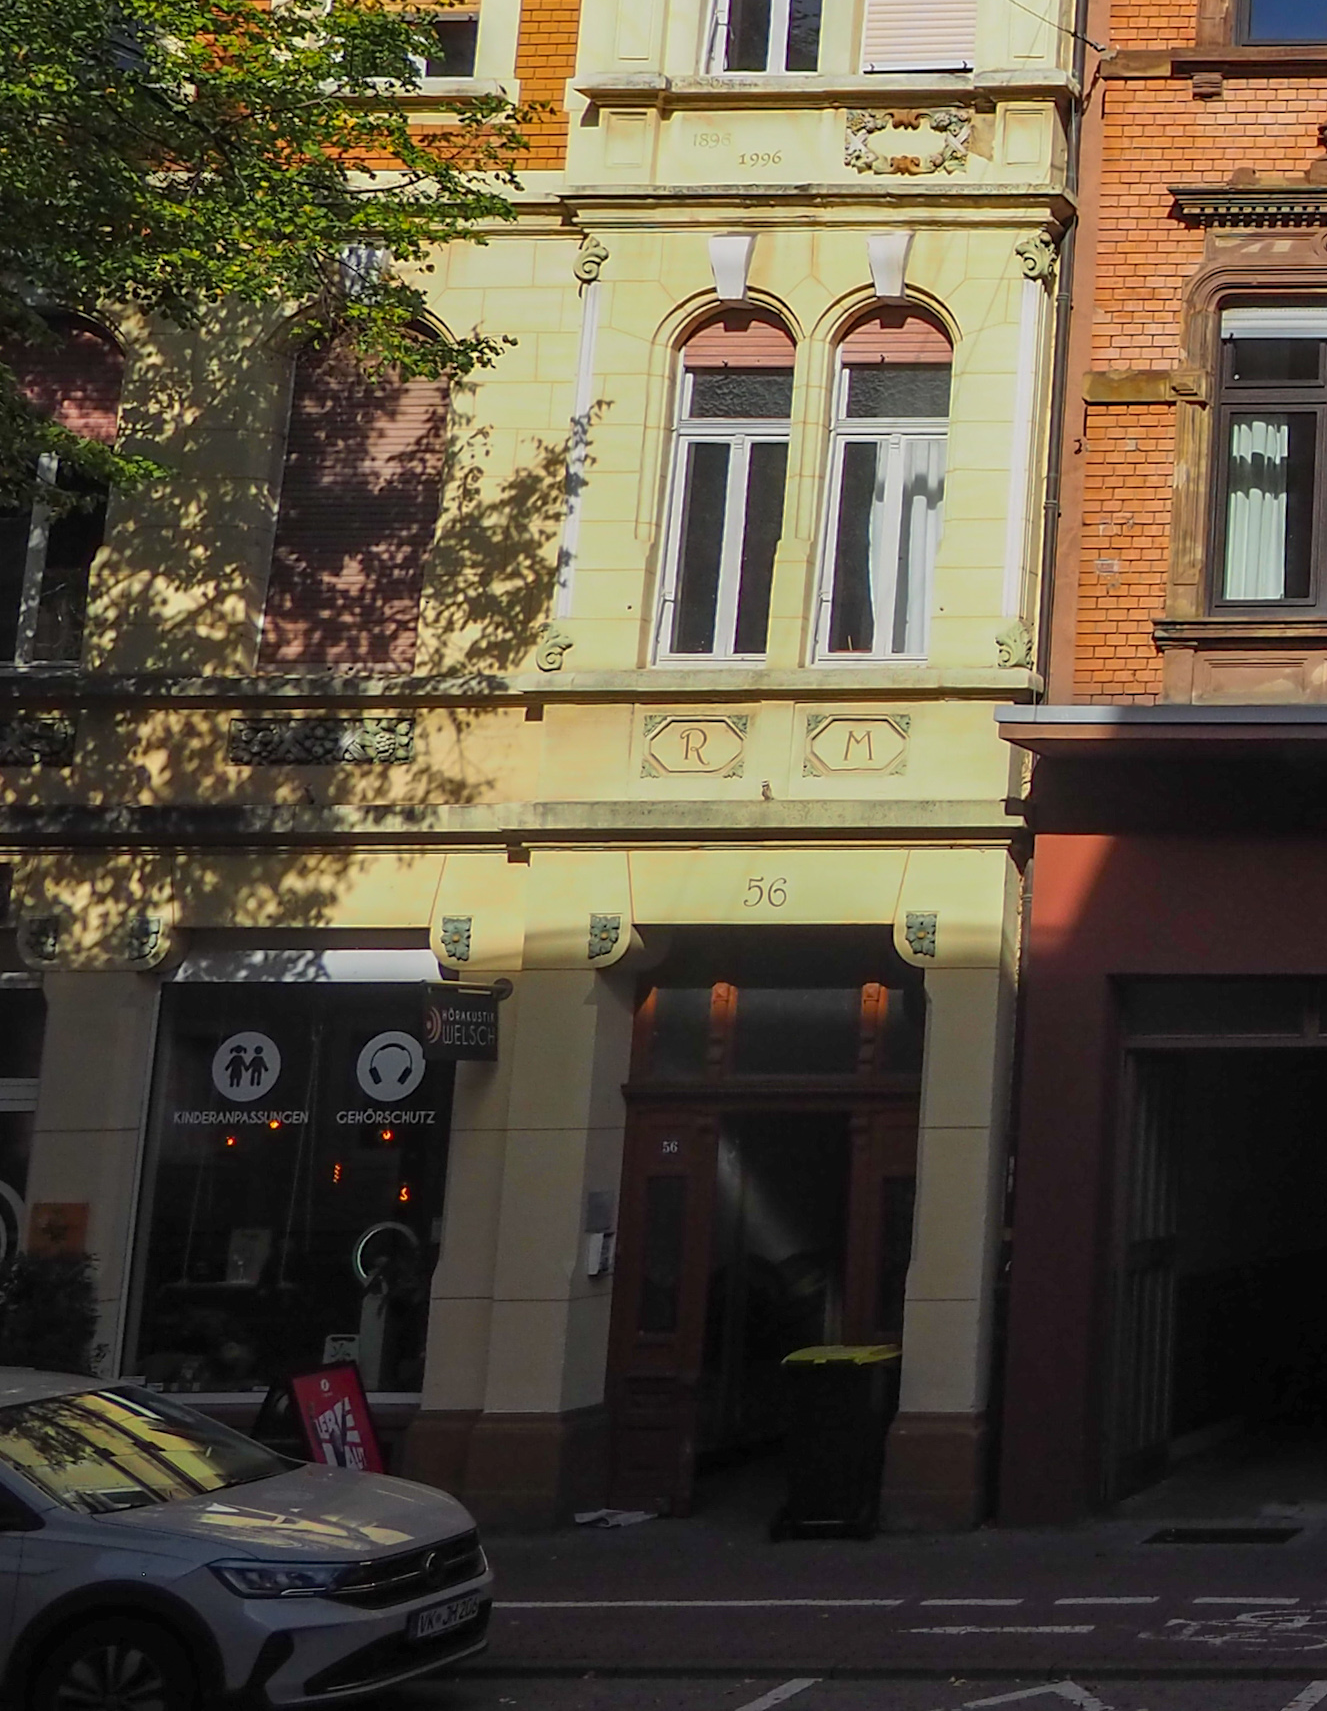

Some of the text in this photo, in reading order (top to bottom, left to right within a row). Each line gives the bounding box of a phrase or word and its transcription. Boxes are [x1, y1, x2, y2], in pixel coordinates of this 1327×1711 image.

[738, 150, 783, 167] 1996
[679, 727, 710, 766] R
[843, 729, 875, 761] M
[743, 875, 788, 907] 56
[441, 1007, 495, 1023] HÖRAKUSTIK
[442, 1023, 496, 1046] WELSCH
[173, 1109, 310, 1125] KINDERANPASSUNGEN
[336, 1107, 436, 1125] GEHÖRSCHUTZ
[662, 1140, 679, 1154] 56
